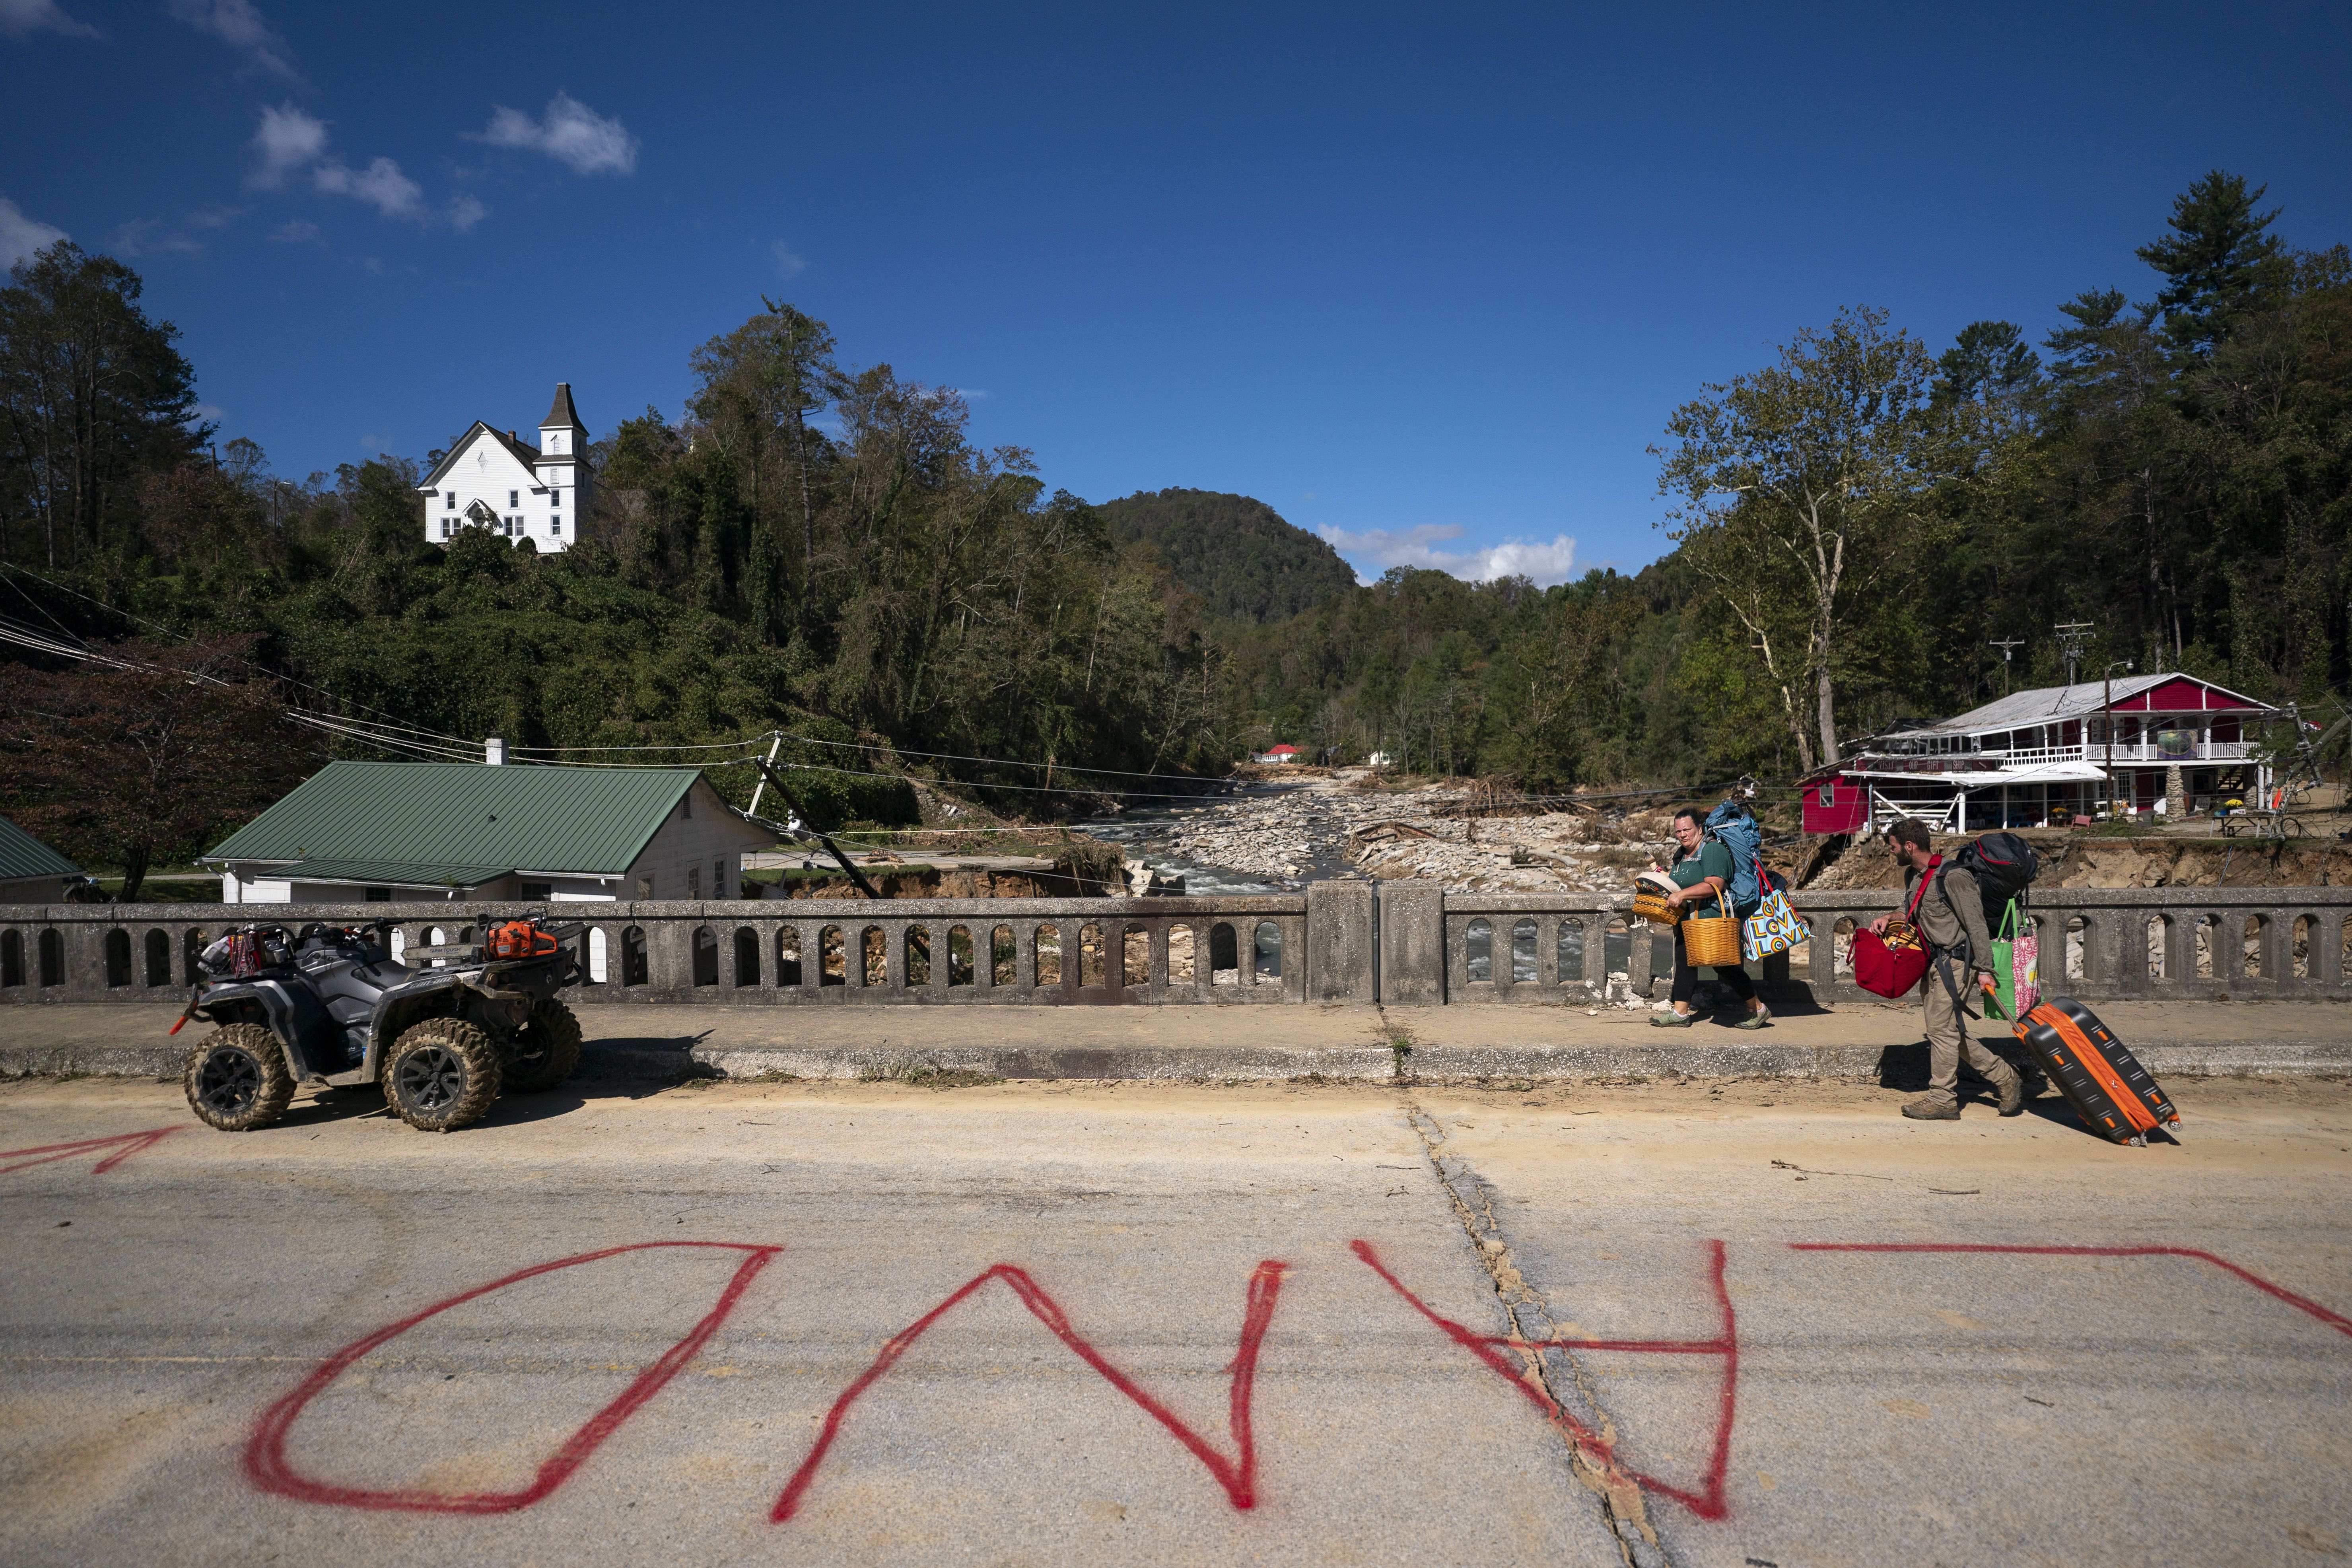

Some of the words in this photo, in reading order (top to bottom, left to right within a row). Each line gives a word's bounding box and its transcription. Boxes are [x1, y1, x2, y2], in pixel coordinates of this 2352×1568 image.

[1879, 760, 1894, 770] VISIT
[1909, 761, 1918, 770] OUR
[1927, 760, 1939, 770] GIFT
[1953, 760, 1965, 770] SHOP
